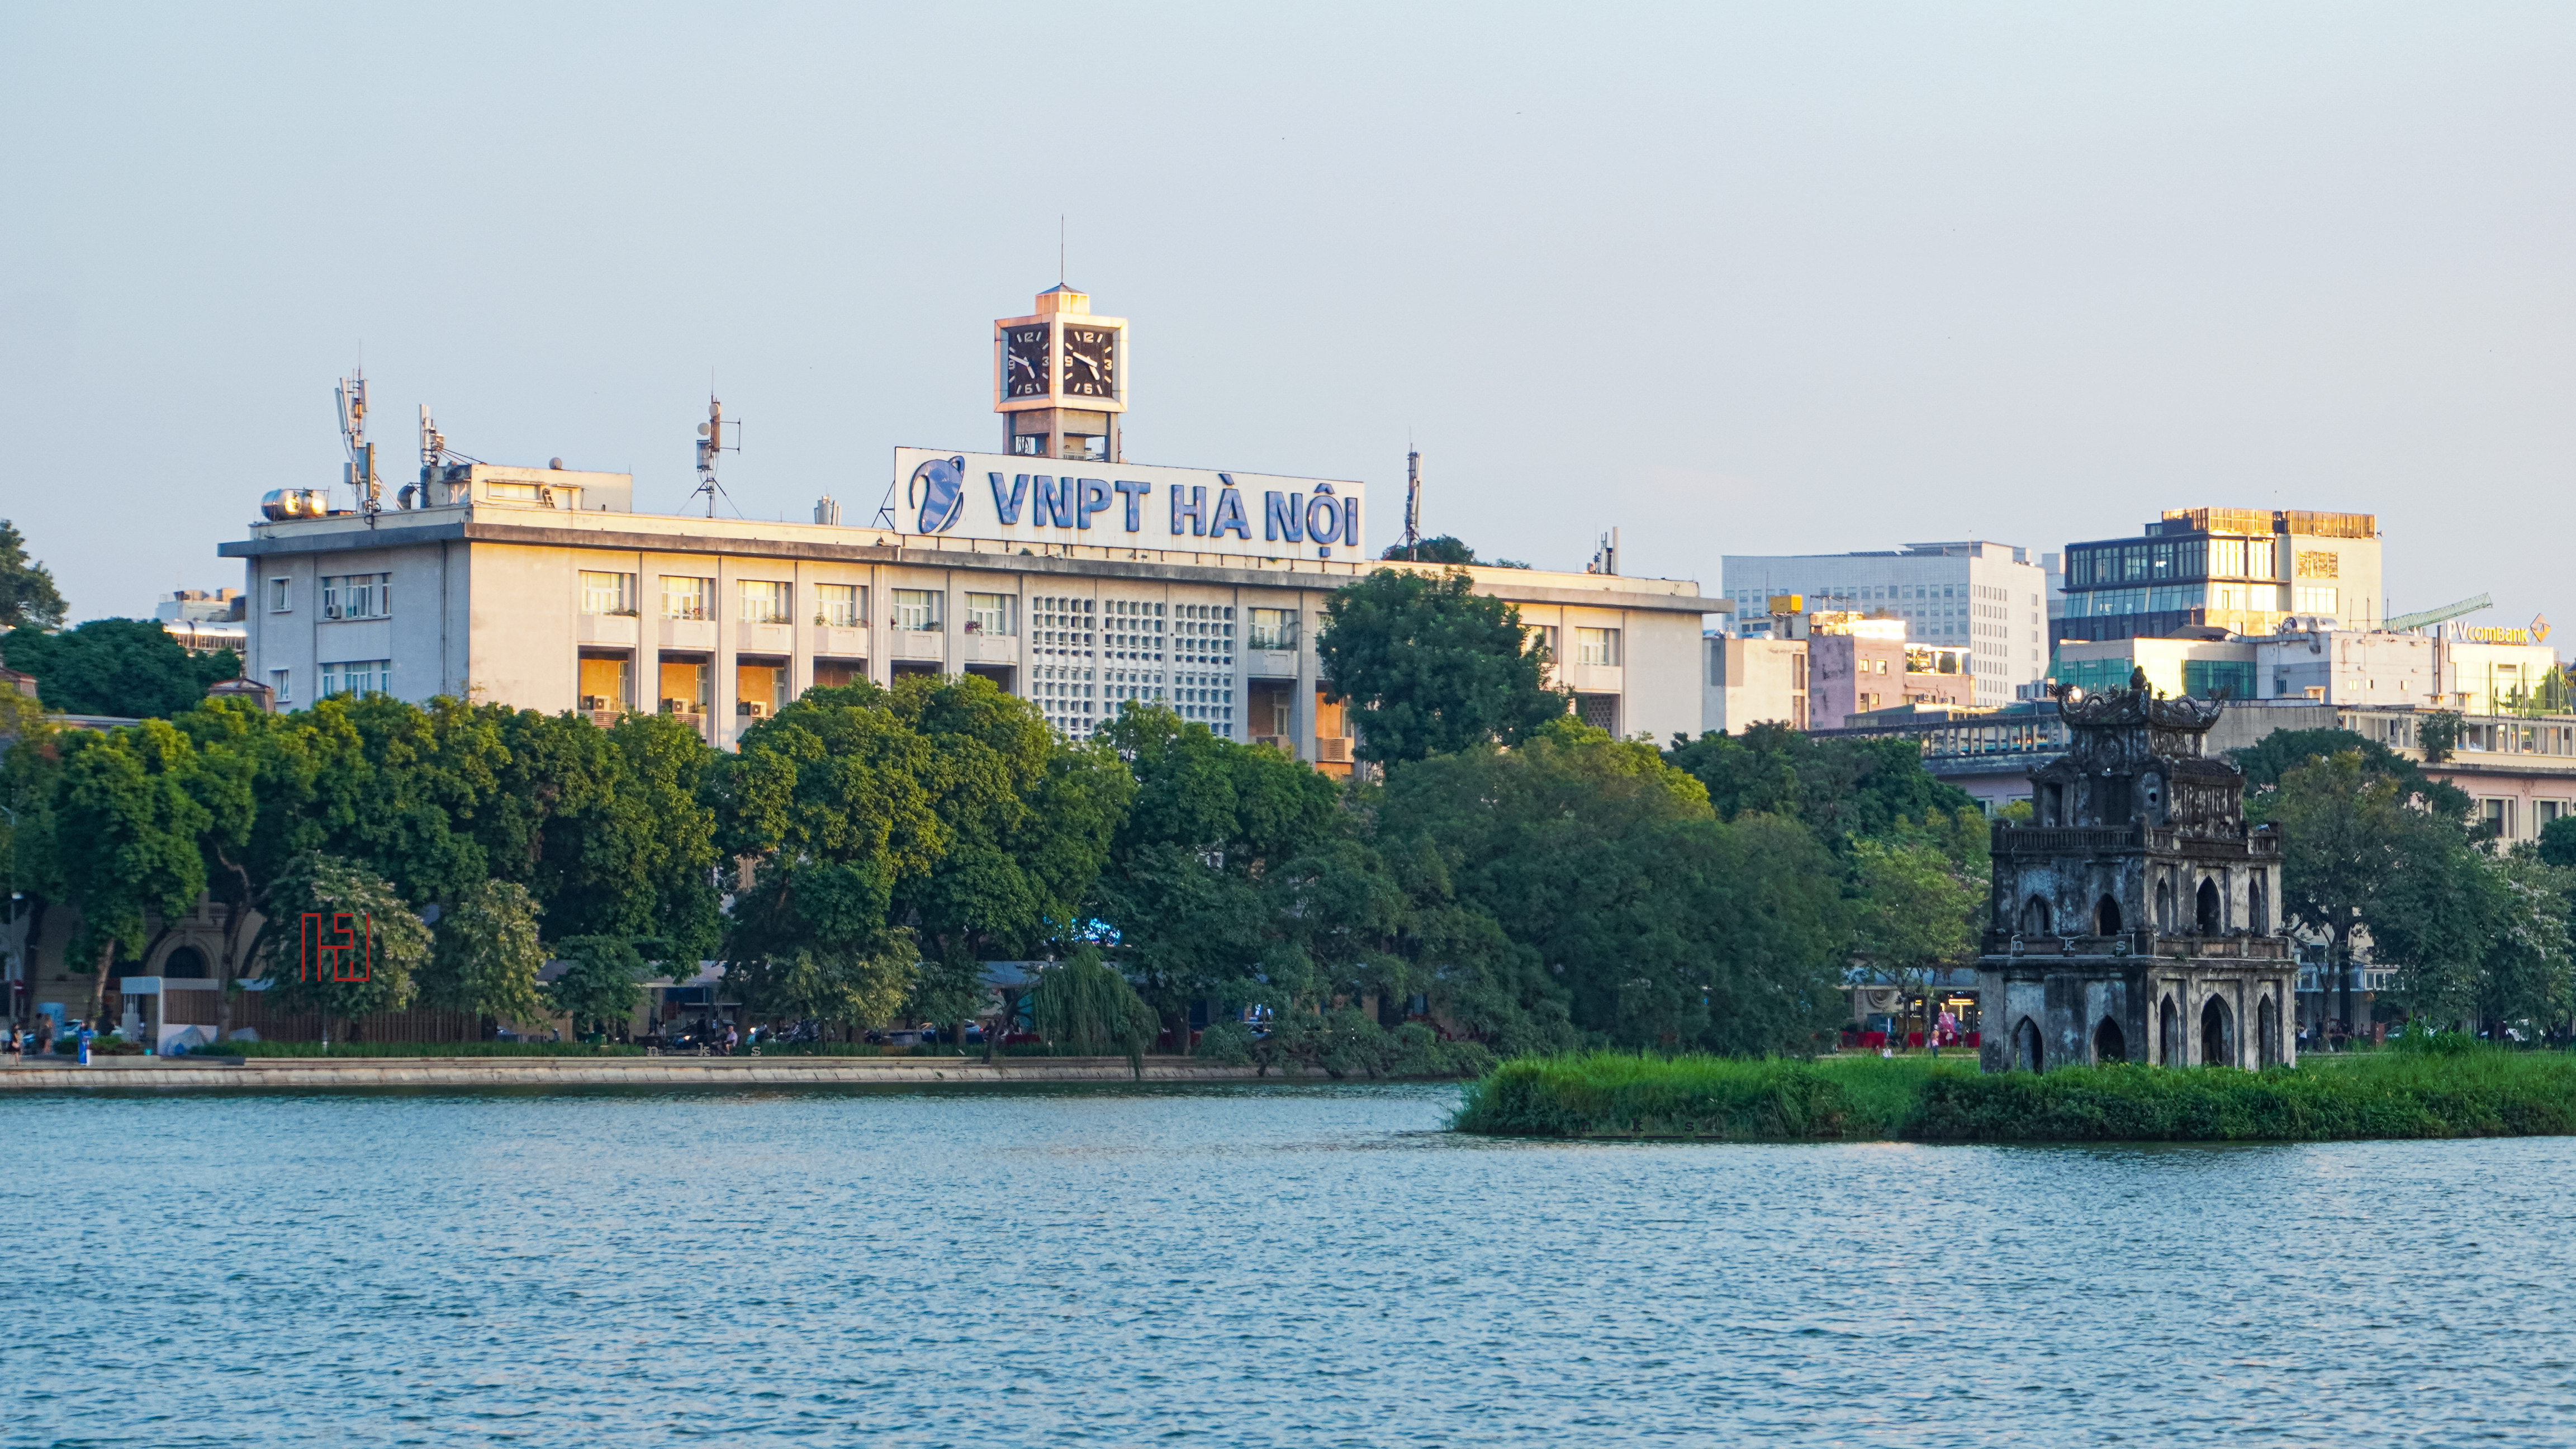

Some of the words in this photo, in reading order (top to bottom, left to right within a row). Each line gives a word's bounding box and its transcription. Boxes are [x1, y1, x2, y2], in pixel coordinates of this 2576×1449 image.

[1024, 332, 1034, 343] 12
[1083, 332, 1094, 343] 12
[1008, 360, 1015, 370] 9
[1042, 356, 1049, 367] 3
[1065, 356, 1073, 367] 9
[1104, 359, 1112, 370] 3
[1024, 384, 1033, 394] 6
[1084, 383, 1092, 394] 6
[988, 472, 1151, 532] VNPT
[1170, 473, 1251, 539] HÀ
[1265, 484, 1358, 557] NỘI
[2446, 620, 2530, 642] PVcomBank
